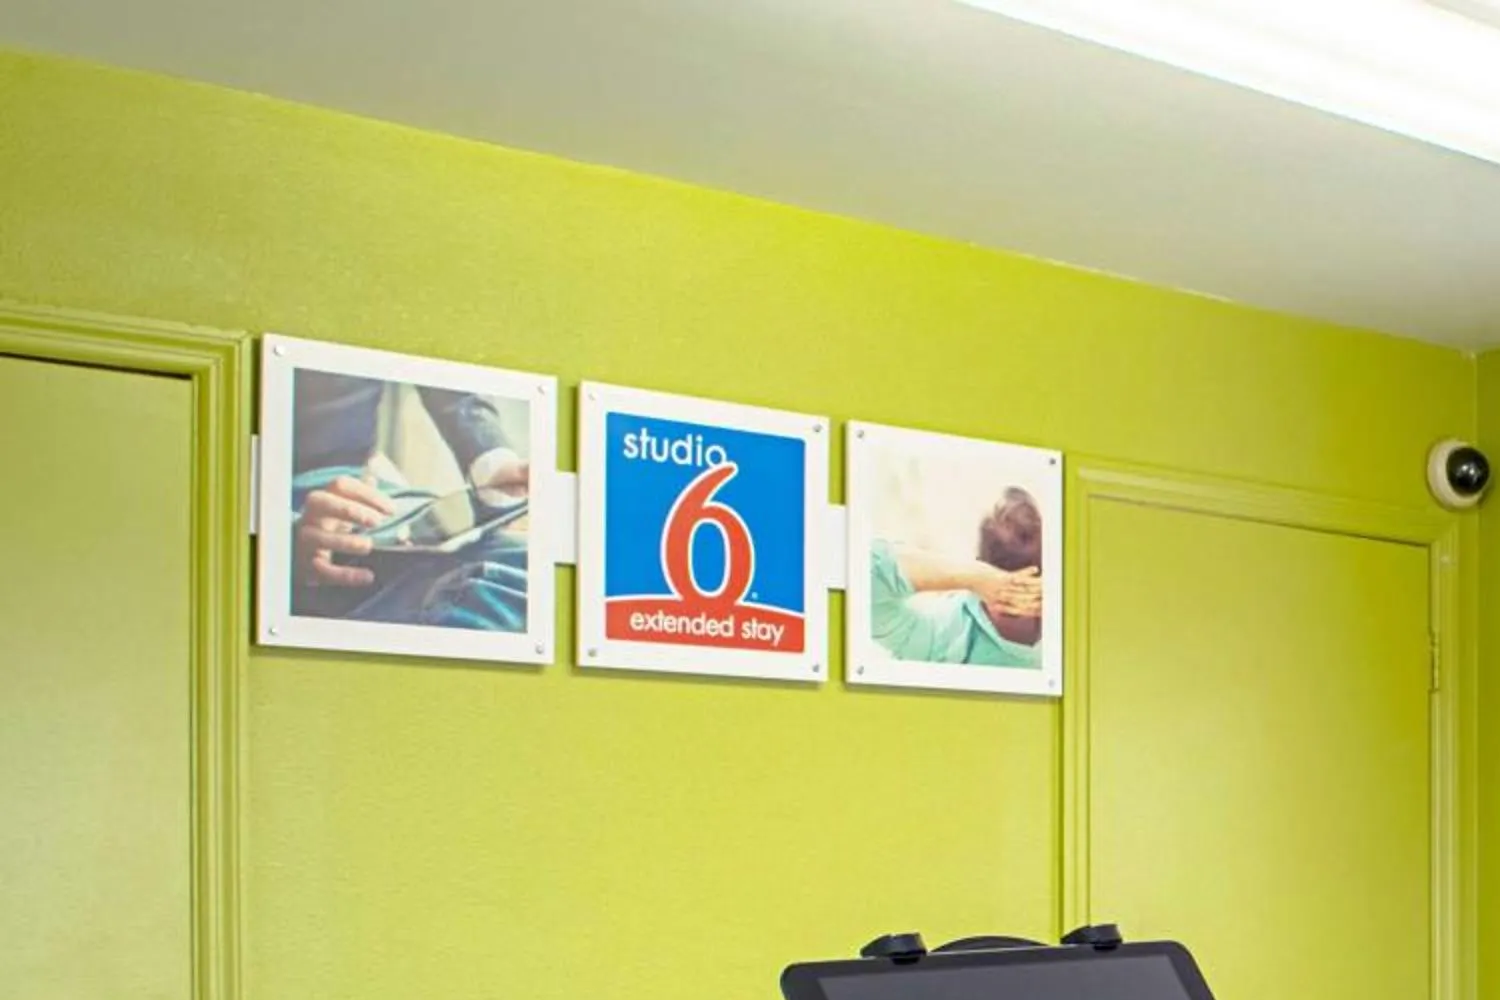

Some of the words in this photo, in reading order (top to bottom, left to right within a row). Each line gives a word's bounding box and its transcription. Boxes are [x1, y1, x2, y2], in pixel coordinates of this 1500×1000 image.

[623, 428, 727, 467] studio
[660, 461, 755, 606] 6
[630, 610, 734, 637] extended
[741, 621, 785, 647] stay
